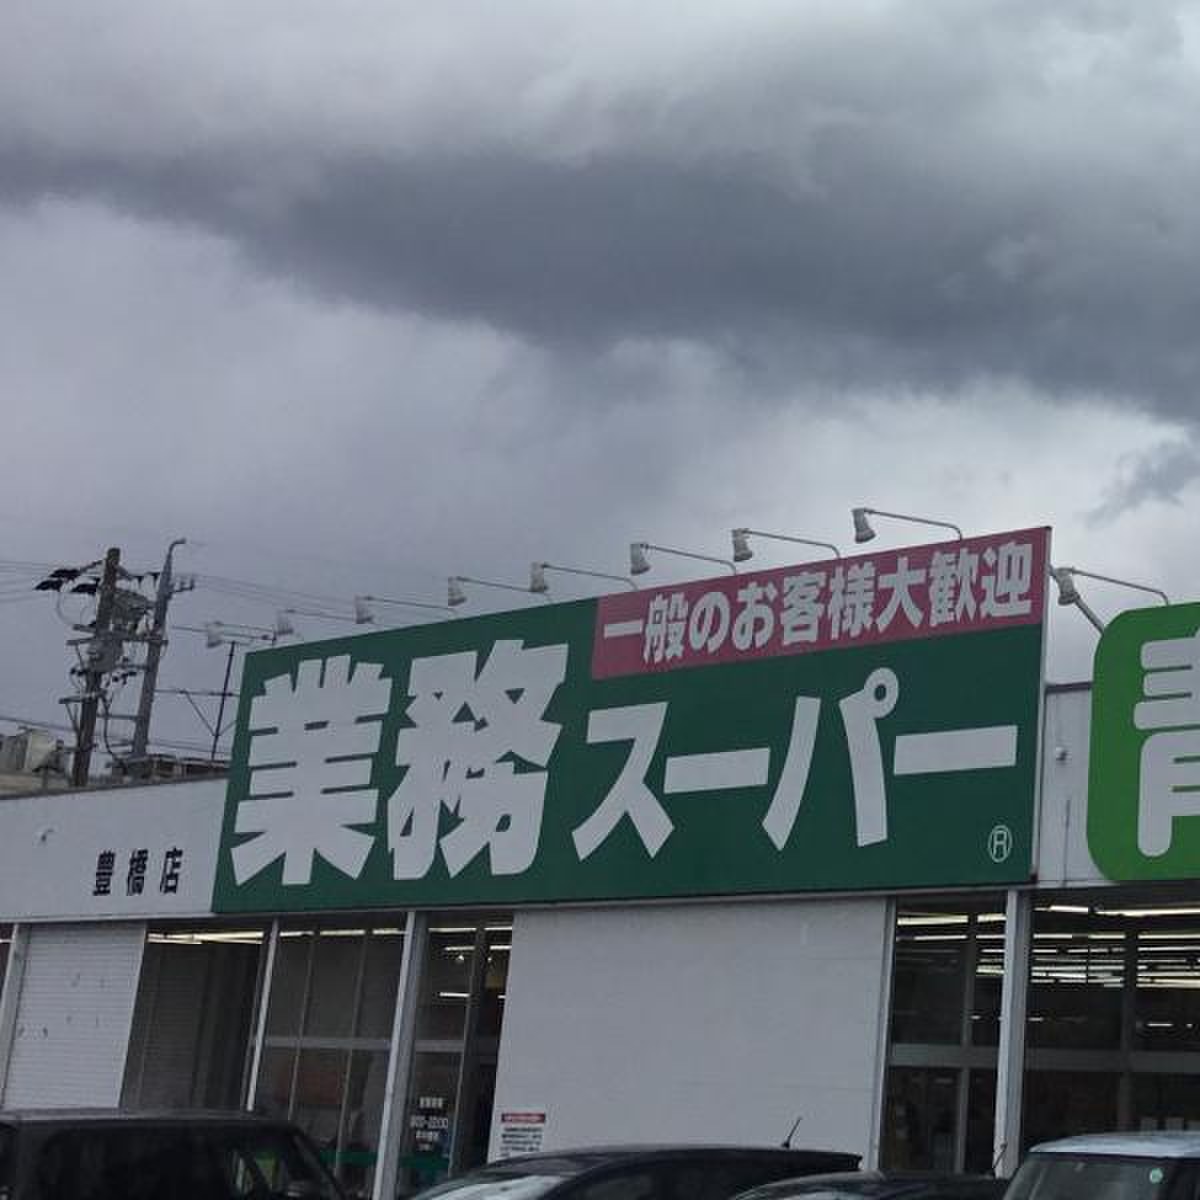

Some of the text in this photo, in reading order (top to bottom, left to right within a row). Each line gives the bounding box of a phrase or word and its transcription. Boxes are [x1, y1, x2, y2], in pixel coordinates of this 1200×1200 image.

[603, 541, 1033, 662] 一般のお客様大歓迎
[230, 638, 1018, 886] 業務スーパー
